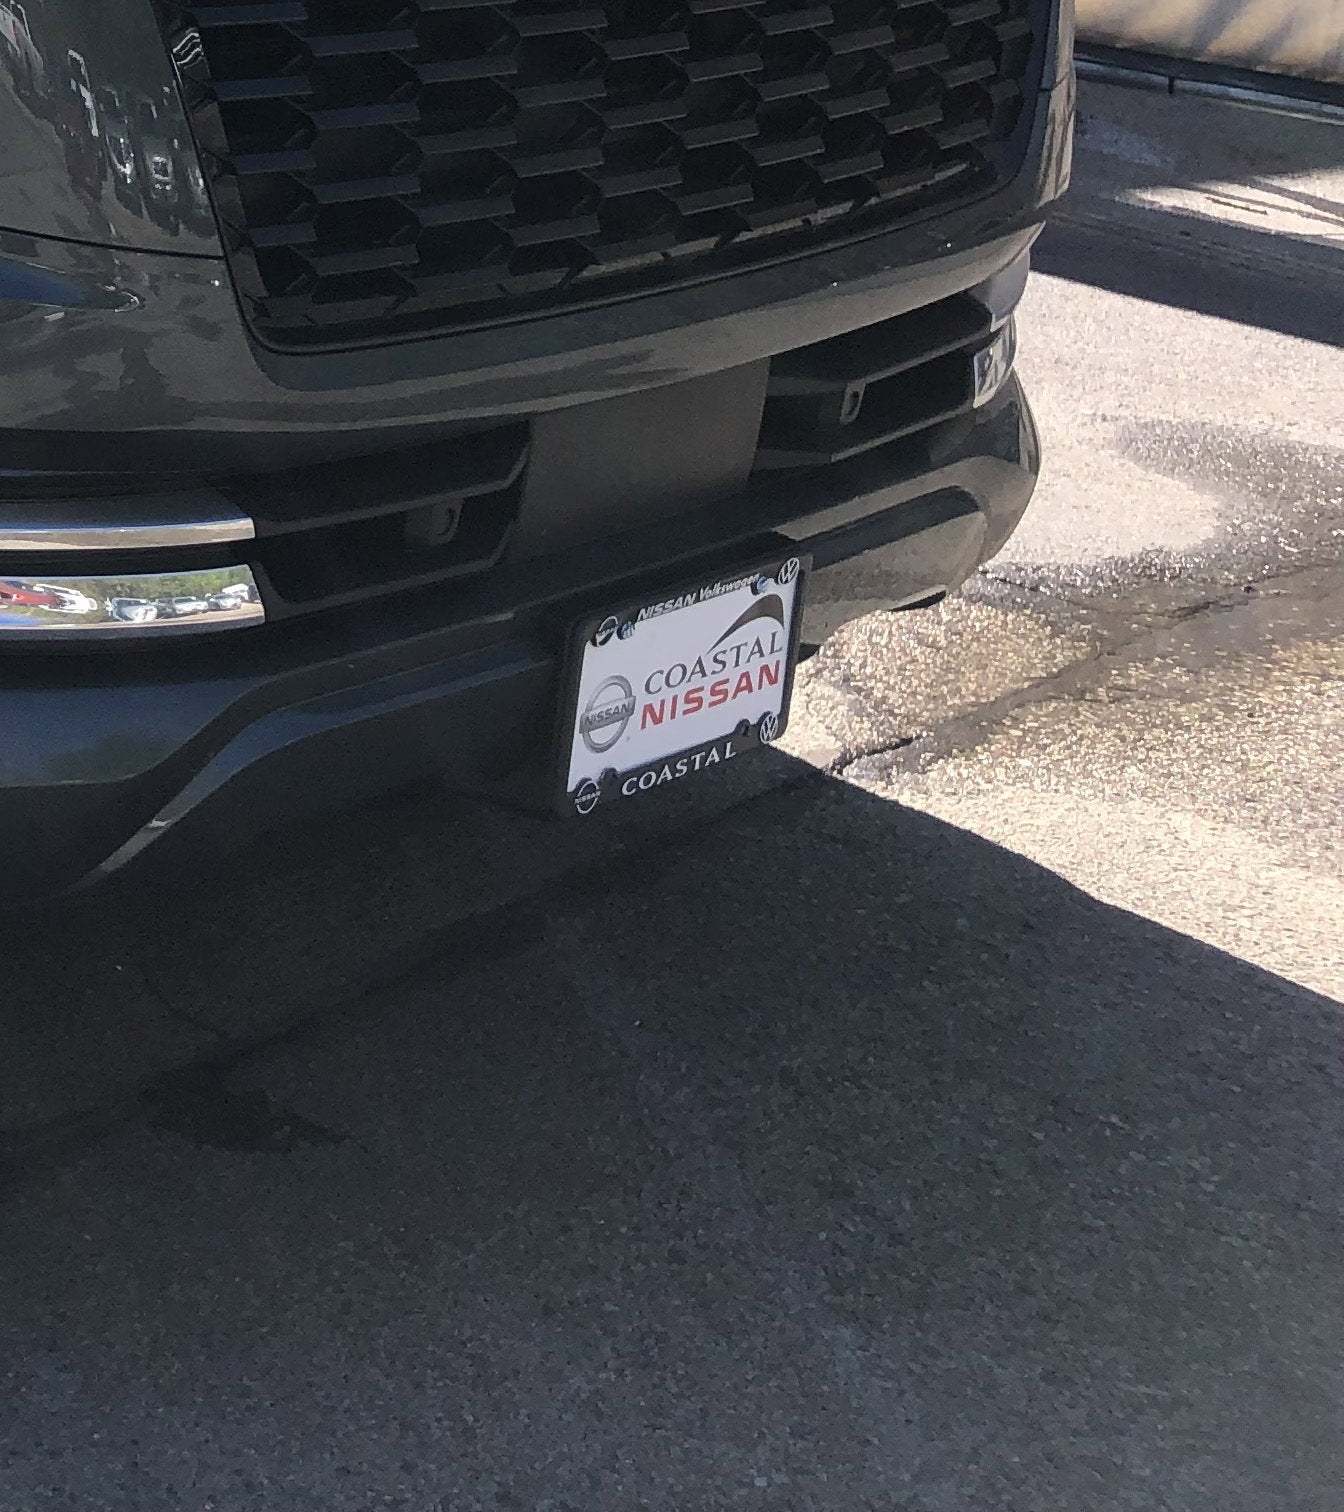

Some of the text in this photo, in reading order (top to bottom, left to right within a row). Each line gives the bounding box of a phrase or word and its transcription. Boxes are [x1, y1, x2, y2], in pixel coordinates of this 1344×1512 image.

[637, 592, 697, 623] NISSAN
[644, 630, 783, 695] COASTAL
[584, 699, 632, 727] NISSAN
[640, 660, 780, 730] NISSAN
[621, 741, 737, 796] COASTAL
